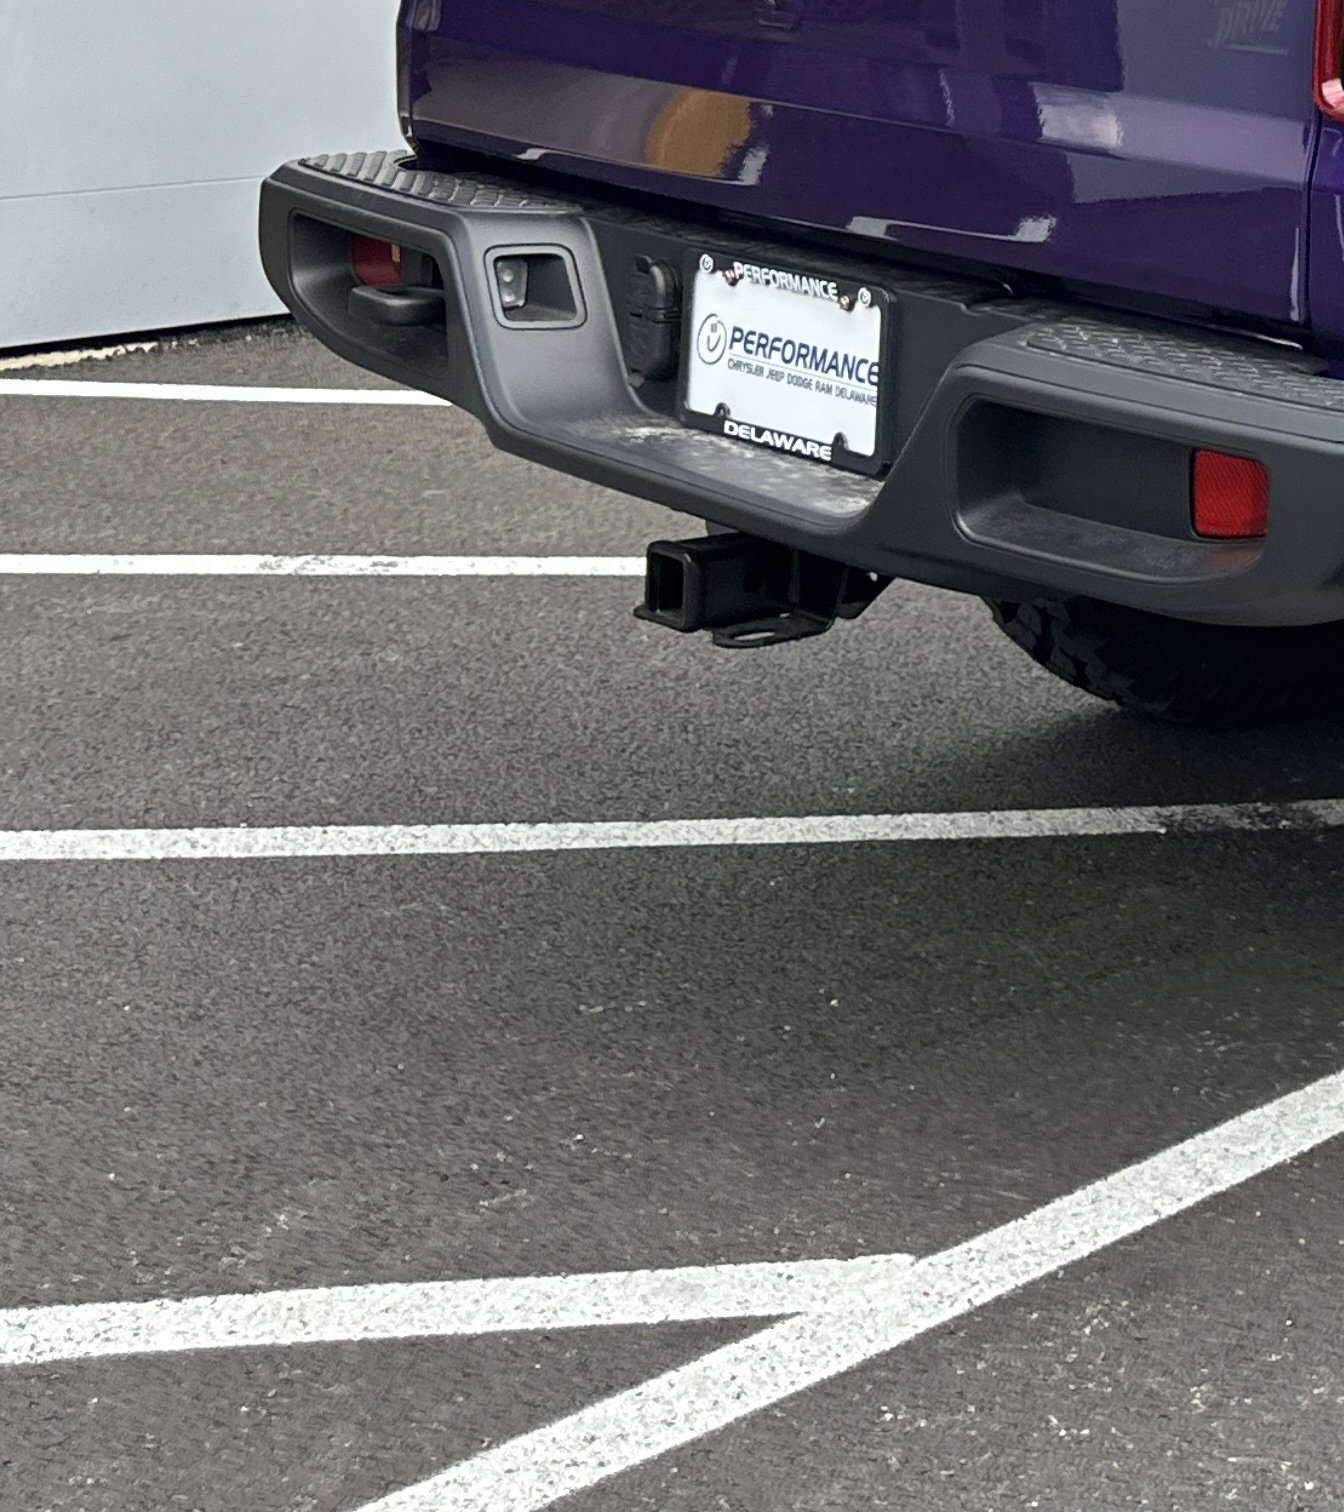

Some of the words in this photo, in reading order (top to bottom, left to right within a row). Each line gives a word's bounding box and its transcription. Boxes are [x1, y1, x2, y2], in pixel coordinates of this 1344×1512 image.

[733, 261, 839, 301] PERFORMANCE
[729, 326, 879, 385] PERFORMANCE
[727, 358, 764, 378] CHRYSLER
[766, 365, 785, 383] JEEP
[787, 373, 813, 391] DODGE
[815, 380, 833, 396] RAM
[723, 420, 832, 462] DELAWARE
